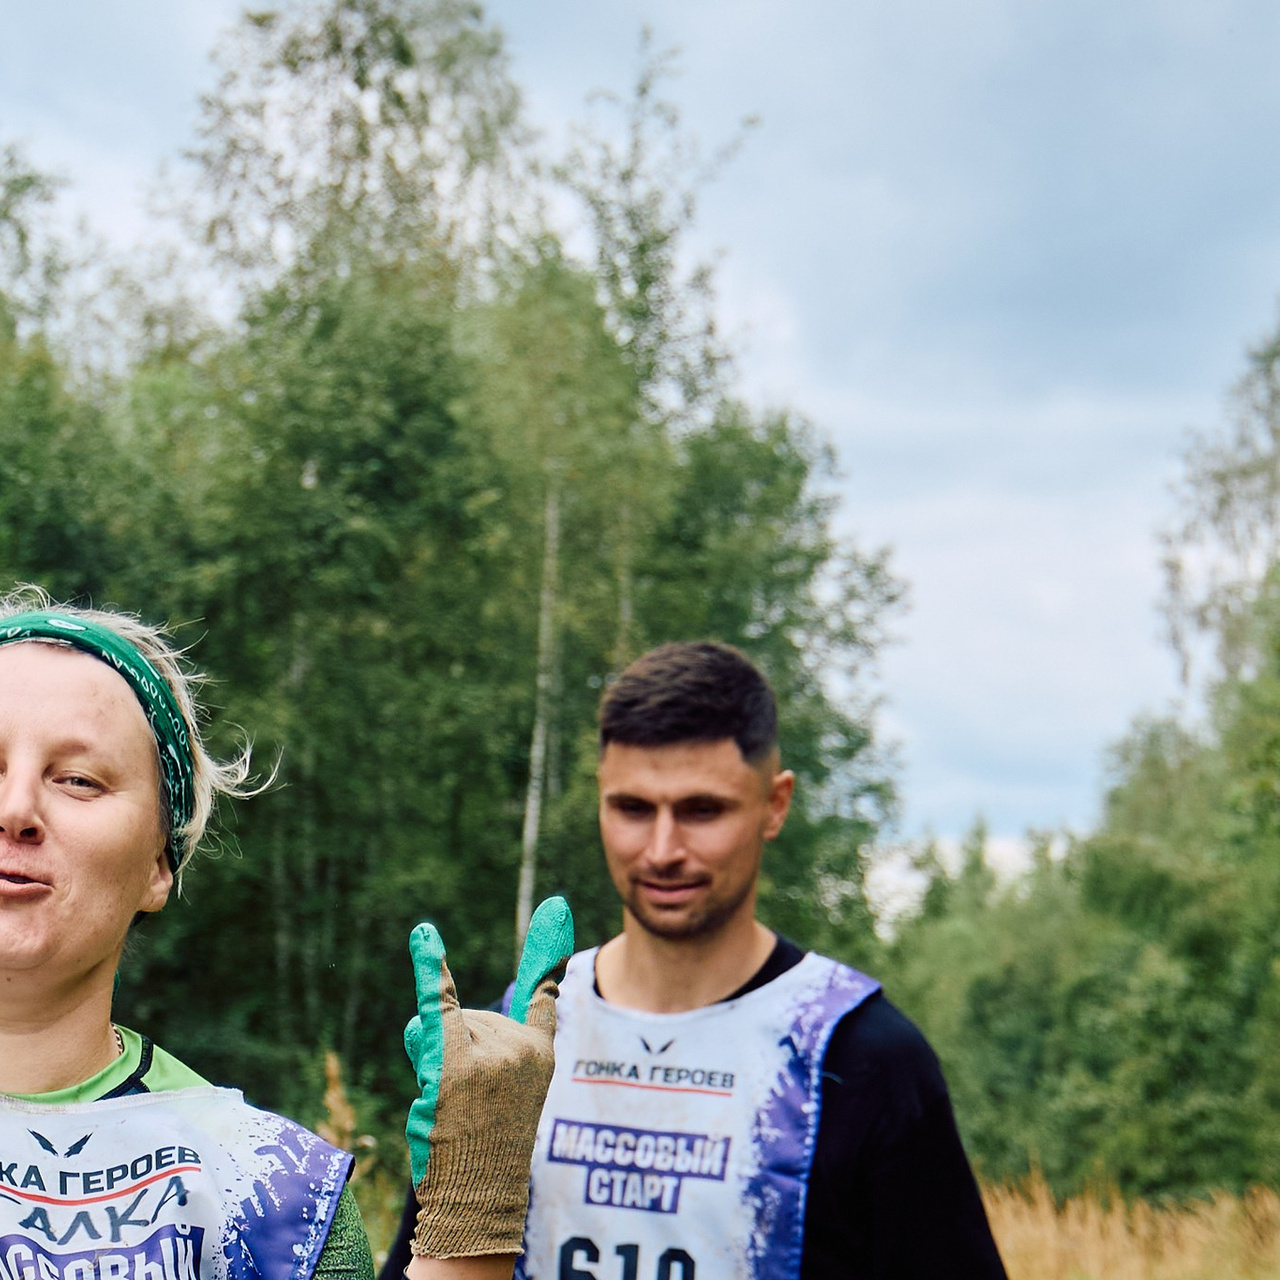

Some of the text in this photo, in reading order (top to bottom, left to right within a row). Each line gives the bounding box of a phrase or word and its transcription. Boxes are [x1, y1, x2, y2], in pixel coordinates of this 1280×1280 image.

[573, 1060, 735, 1088] ГОНКА ГЕРОЕВ
[59, 1146, 202, 1195] ГЕРОЕВ
[553, 1123, 726, 1175] МАССОВЫЙ
[588, 1168, 679, 1212] СТАРТ
